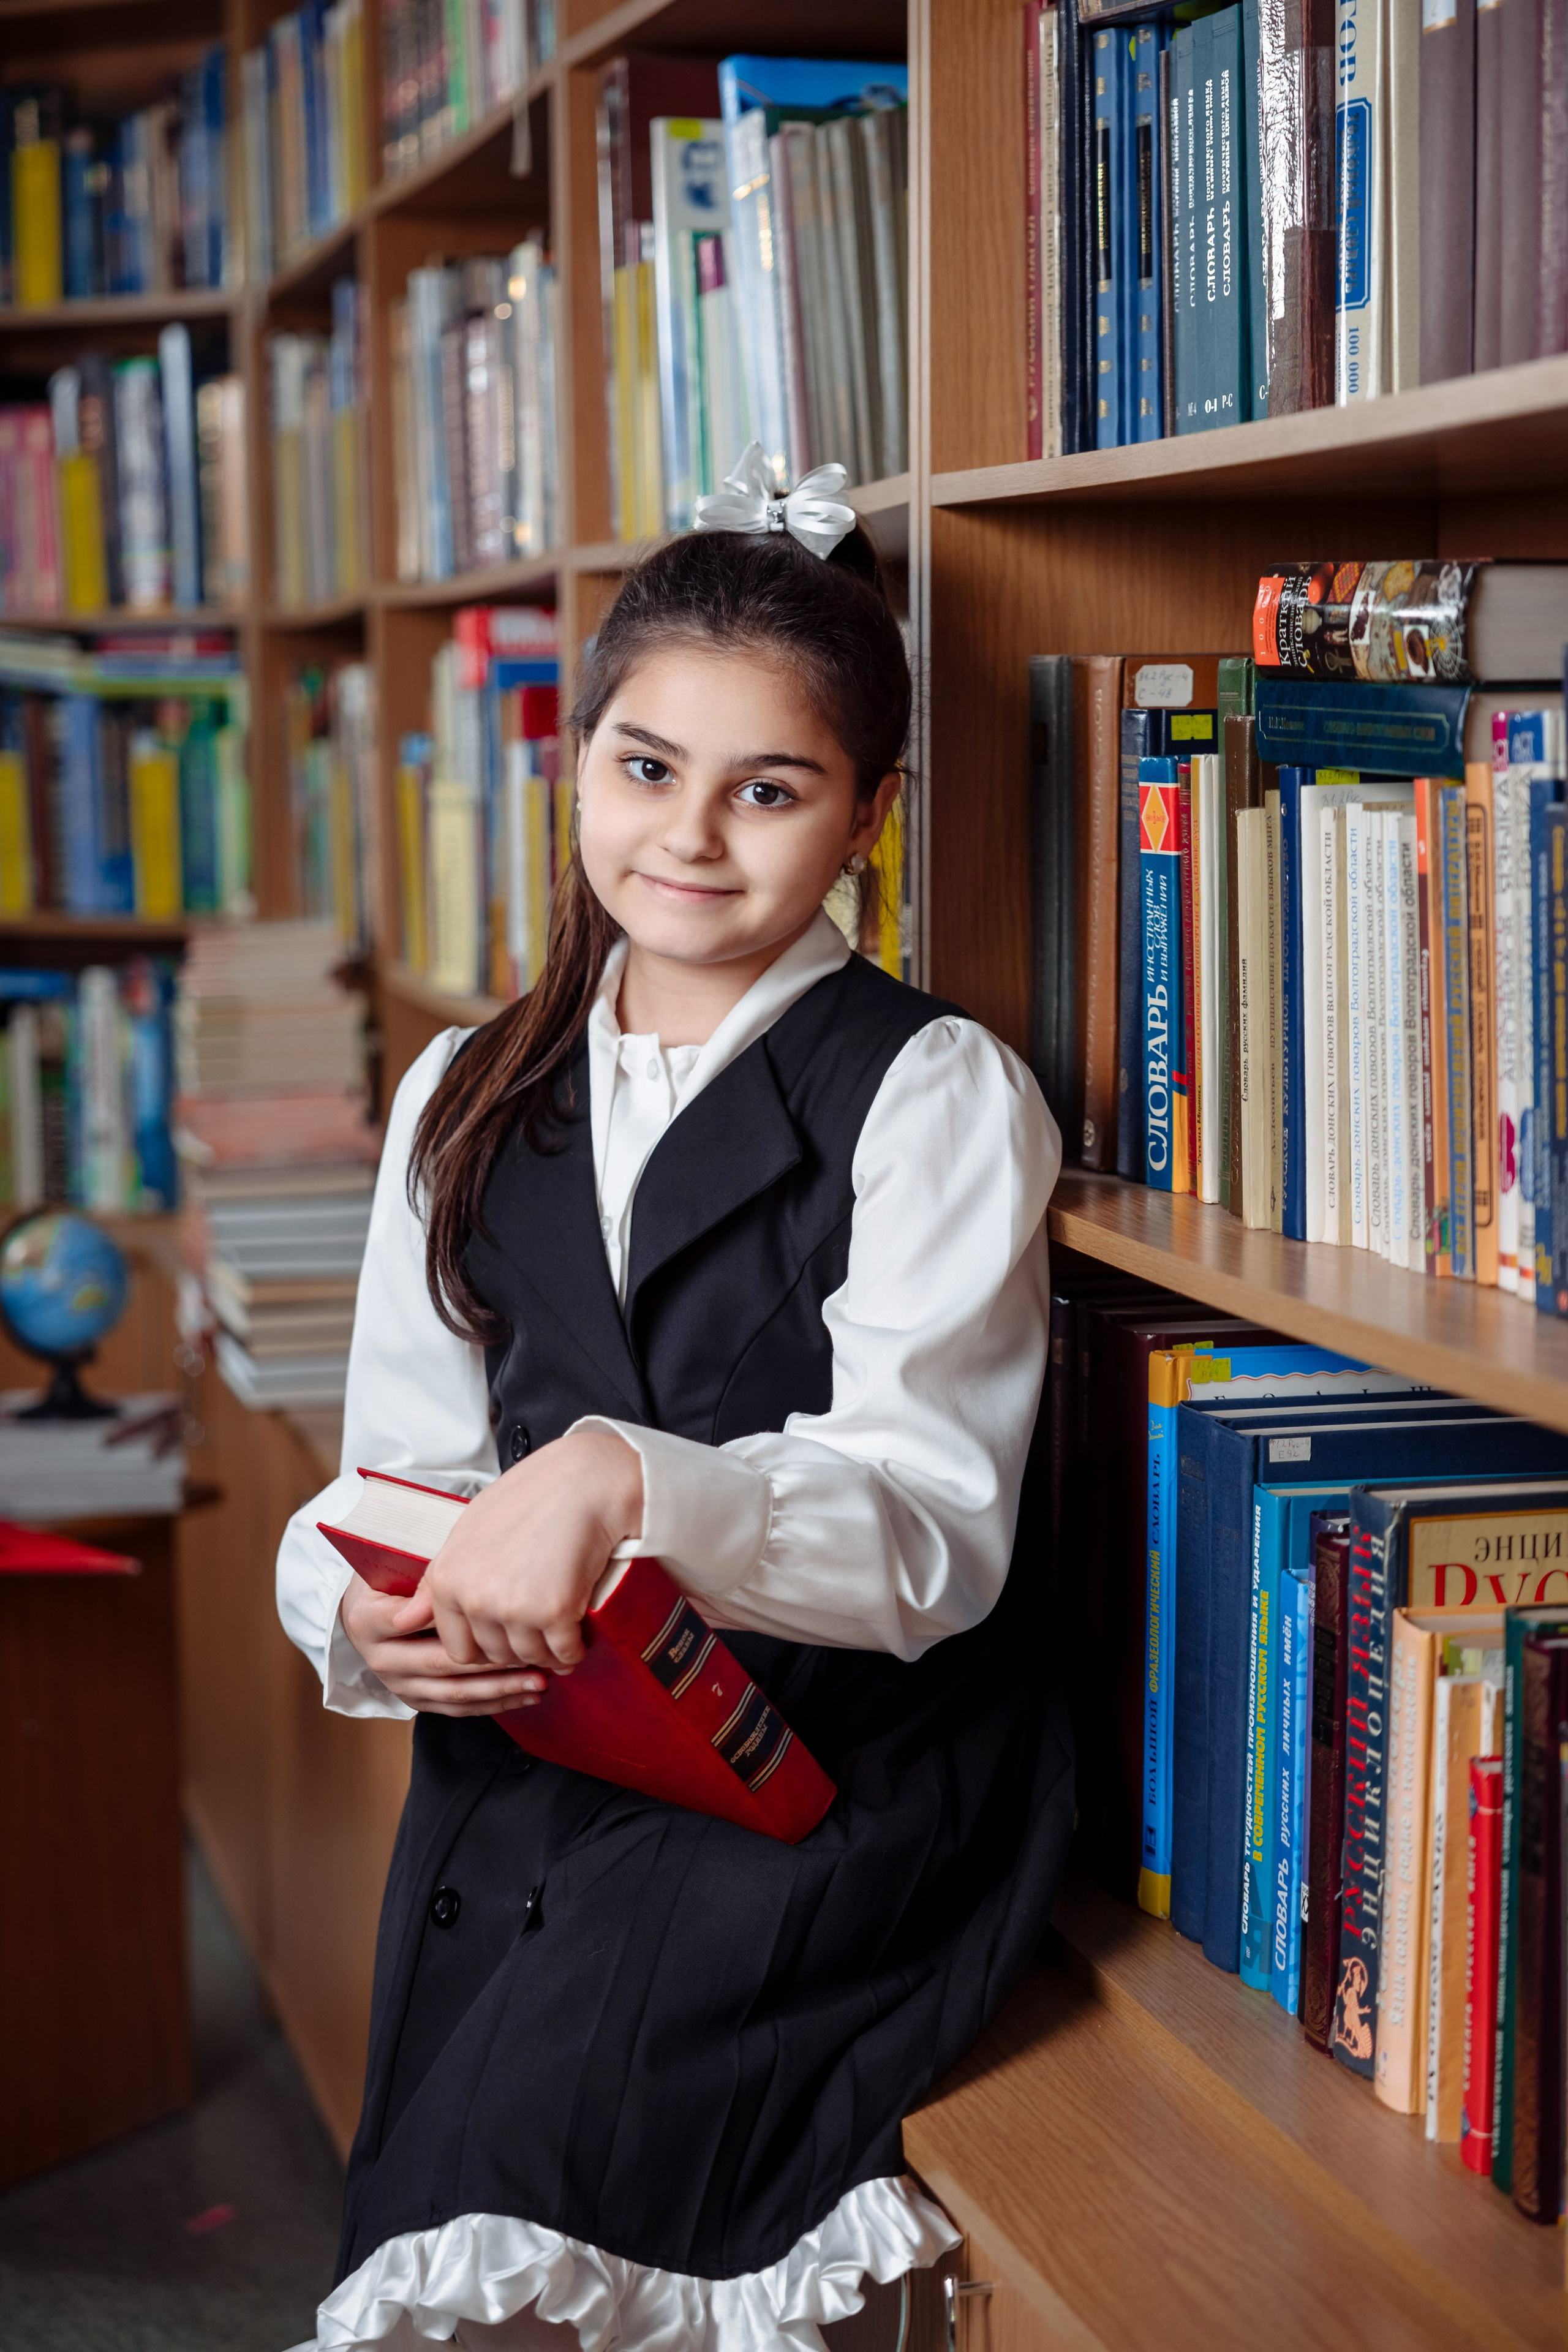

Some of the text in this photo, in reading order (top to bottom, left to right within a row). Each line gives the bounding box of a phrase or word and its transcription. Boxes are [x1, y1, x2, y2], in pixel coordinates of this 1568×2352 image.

[1344, 112, 1362, 293] ТОЛКОВЫЙ СЛОВАРЬ
[1348, 326, 1360, 394] 100 000
[1349, 827, 1358, 891] области
[1145, 869, 1155, 982] ИНОСТРАННЫХ
[1159, 875, 1168, 981] И ВЫРАЖЕНИЙ
[1269, 942, 1275, 958] ПО
[1324, 899, 1334, 1011] ВОЛГОГРАДСКОЙ
[1349, 896, 1360, 1011] Волгоградской
[1147, 985, 1169, 1170] СЛОВАРЬ
[1352, 1017, 1361, 1082] говоров
[1363, 836, 1381, 1227] Словарь донских говоров Волгоградской области
[1327, 1081, 1336, 1145] ДОНСКИХ
[1353, 1159, 1362, 1224] Словарь
[1474, 1532, 1568, 1565] ЭНЦИ
[1148, 1453, 1161, 1806] БОЛЬШОЙ ФРАЗЕОЛОГИЧЕСКИЙ СЛОВАРЬ
[711, 1682, 723, 1697] 7
[1242, 1504, 1261, 1935] СЛОВАРЬ ТРУДНОСТЕЙ ПРОИЗНОШЕНИЯ И УДАРЕНИЯ
[1252, 1589, 1269, 1863] В СОВРЕМЕННОМ РУССКОМ ЯЗЫКЕ
[1343, 1525, 1372, 1939] РУССКИЙ ЯЗЫК
[1361, 1534, 1386, 1950] ЭНЦИКЛОПЕДИЯ
[1275, 1614, 1292, 1971] СЛОВАРЬ русских личных имён
